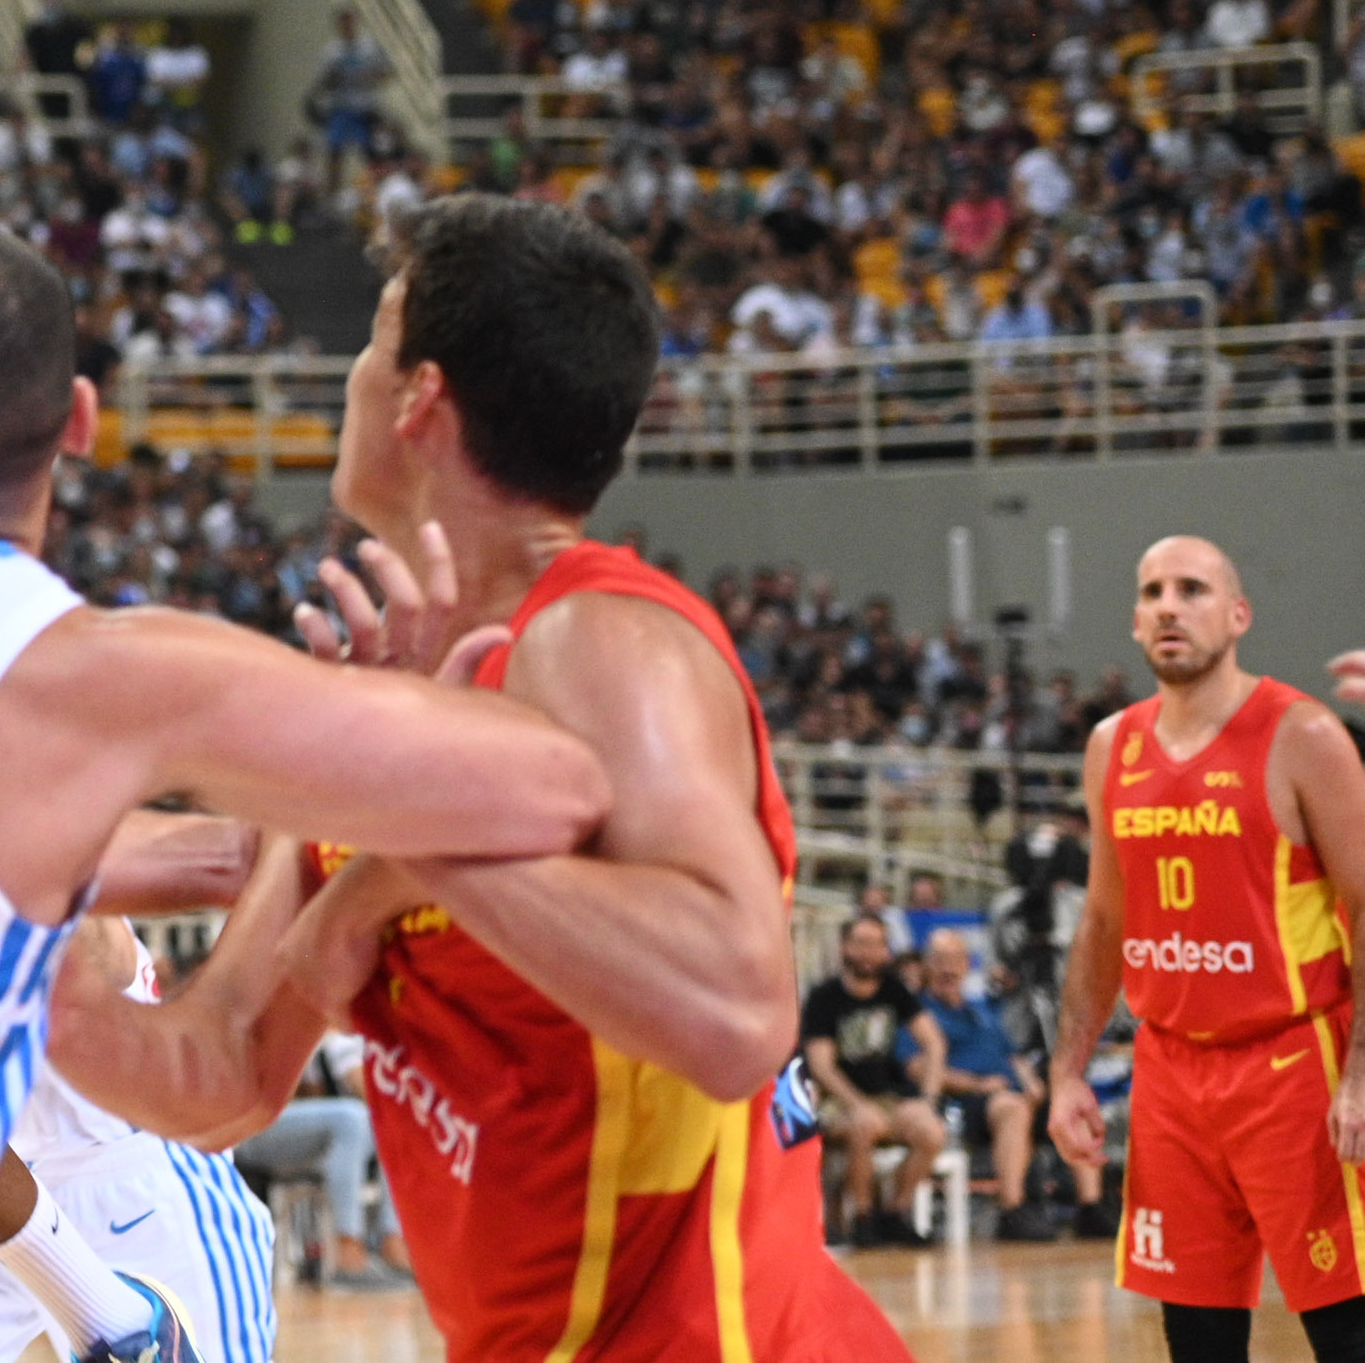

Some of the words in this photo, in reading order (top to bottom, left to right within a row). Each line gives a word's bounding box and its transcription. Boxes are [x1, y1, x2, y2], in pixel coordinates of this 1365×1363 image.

[1113, 799, 1242, 838] ESPAÑA
[1156, 856, 1195, 910] 10
[1123, 931, 1254, 973] endesa
